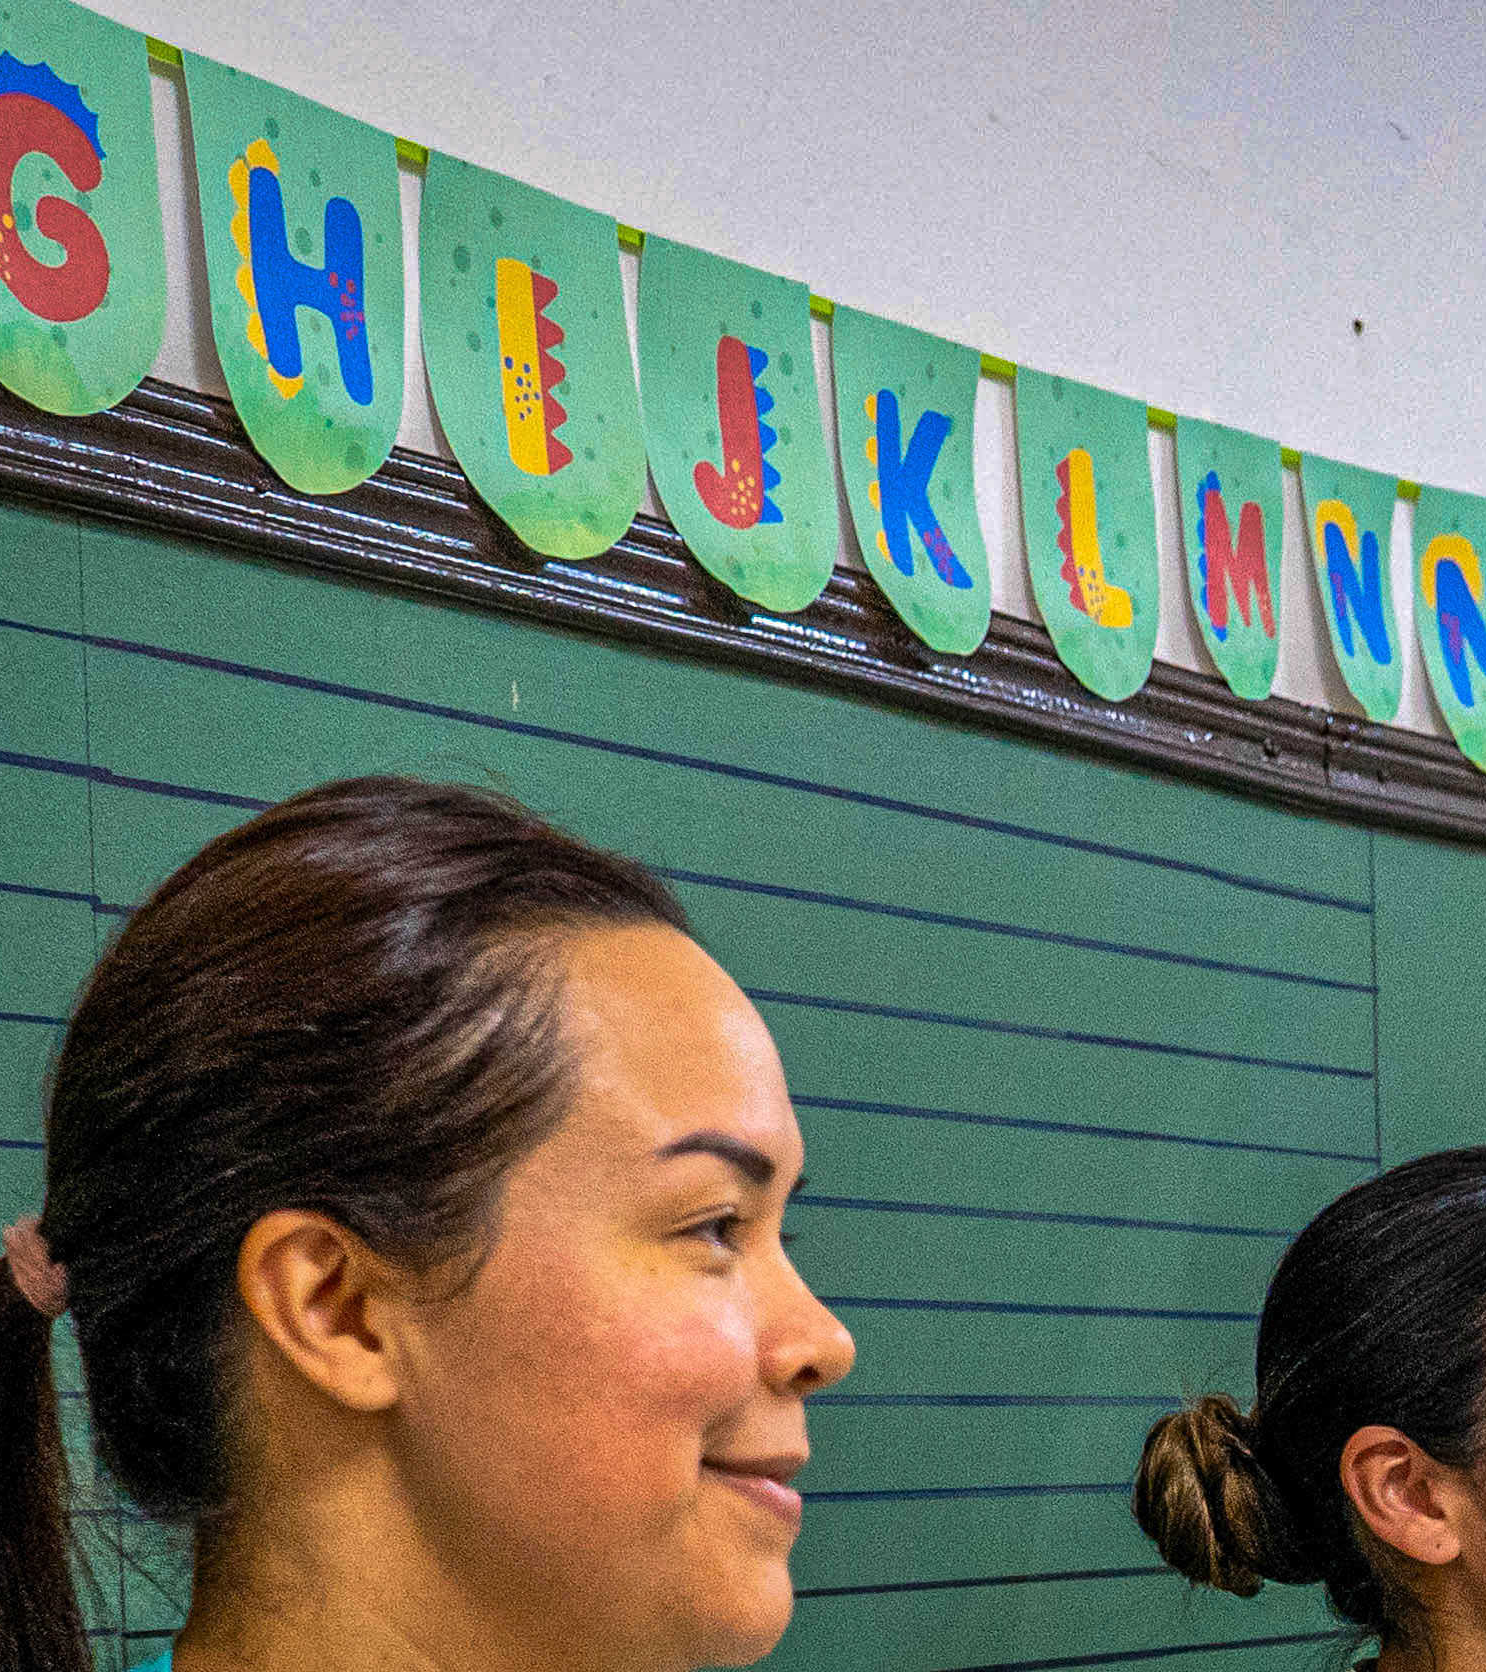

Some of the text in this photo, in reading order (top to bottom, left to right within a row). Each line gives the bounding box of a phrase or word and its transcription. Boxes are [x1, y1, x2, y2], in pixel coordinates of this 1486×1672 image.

[248, 166, 374, 407] H
[495, 258, 551, 477] I
[692, 334, 763, 531] J
[876, 388, 974, 590] K
[1068, 448, 1134, 628] L
[1204, 488, 1276, 640] M
